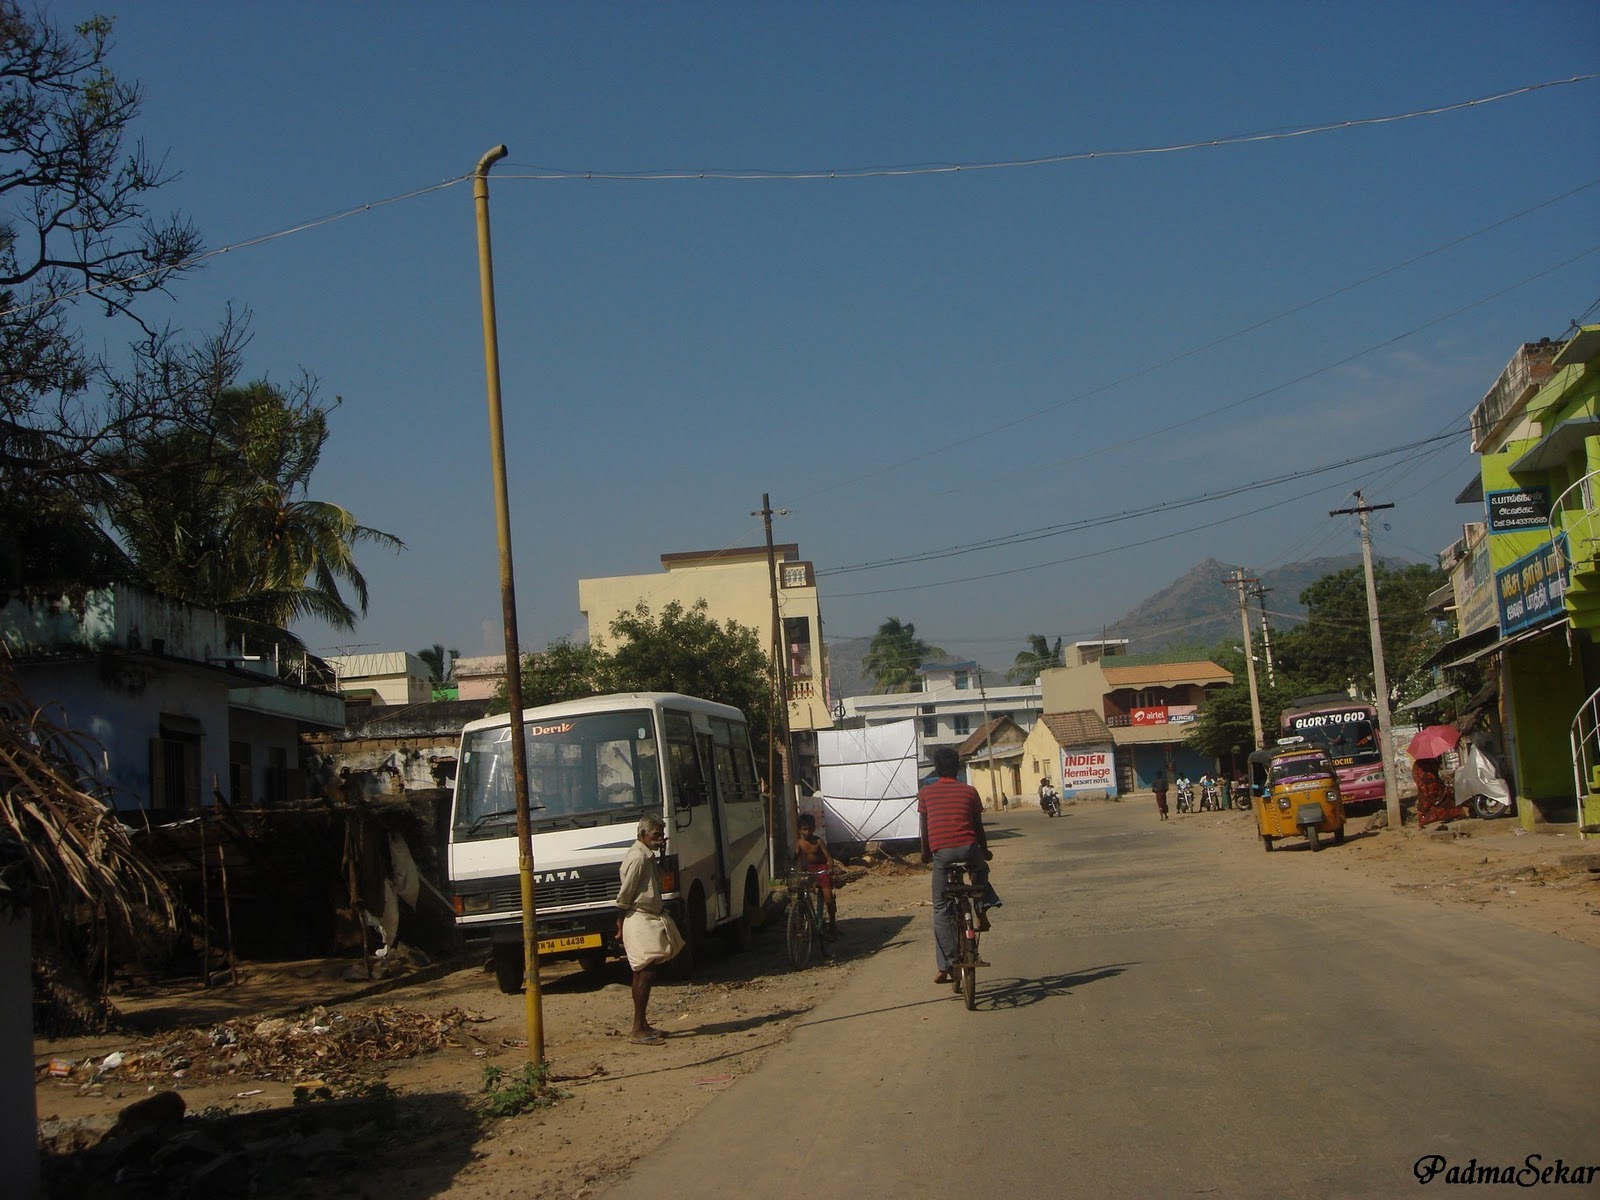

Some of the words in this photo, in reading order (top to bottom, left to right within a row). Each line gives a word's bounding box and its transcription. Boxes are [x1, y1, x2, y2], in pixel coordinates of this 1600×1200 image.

[1146, 711, 1165, 720] airtel
[1295, 715, 1328, 729] GLORY
[1343, 711, 1365, 721] GOD
[532, 722, 576, 736] Derik
[1065, 754, 1106, 767] INDIEN
[1064, 767, 1111, 778] Hermitage
[533, 870, 580, 884] TATA
